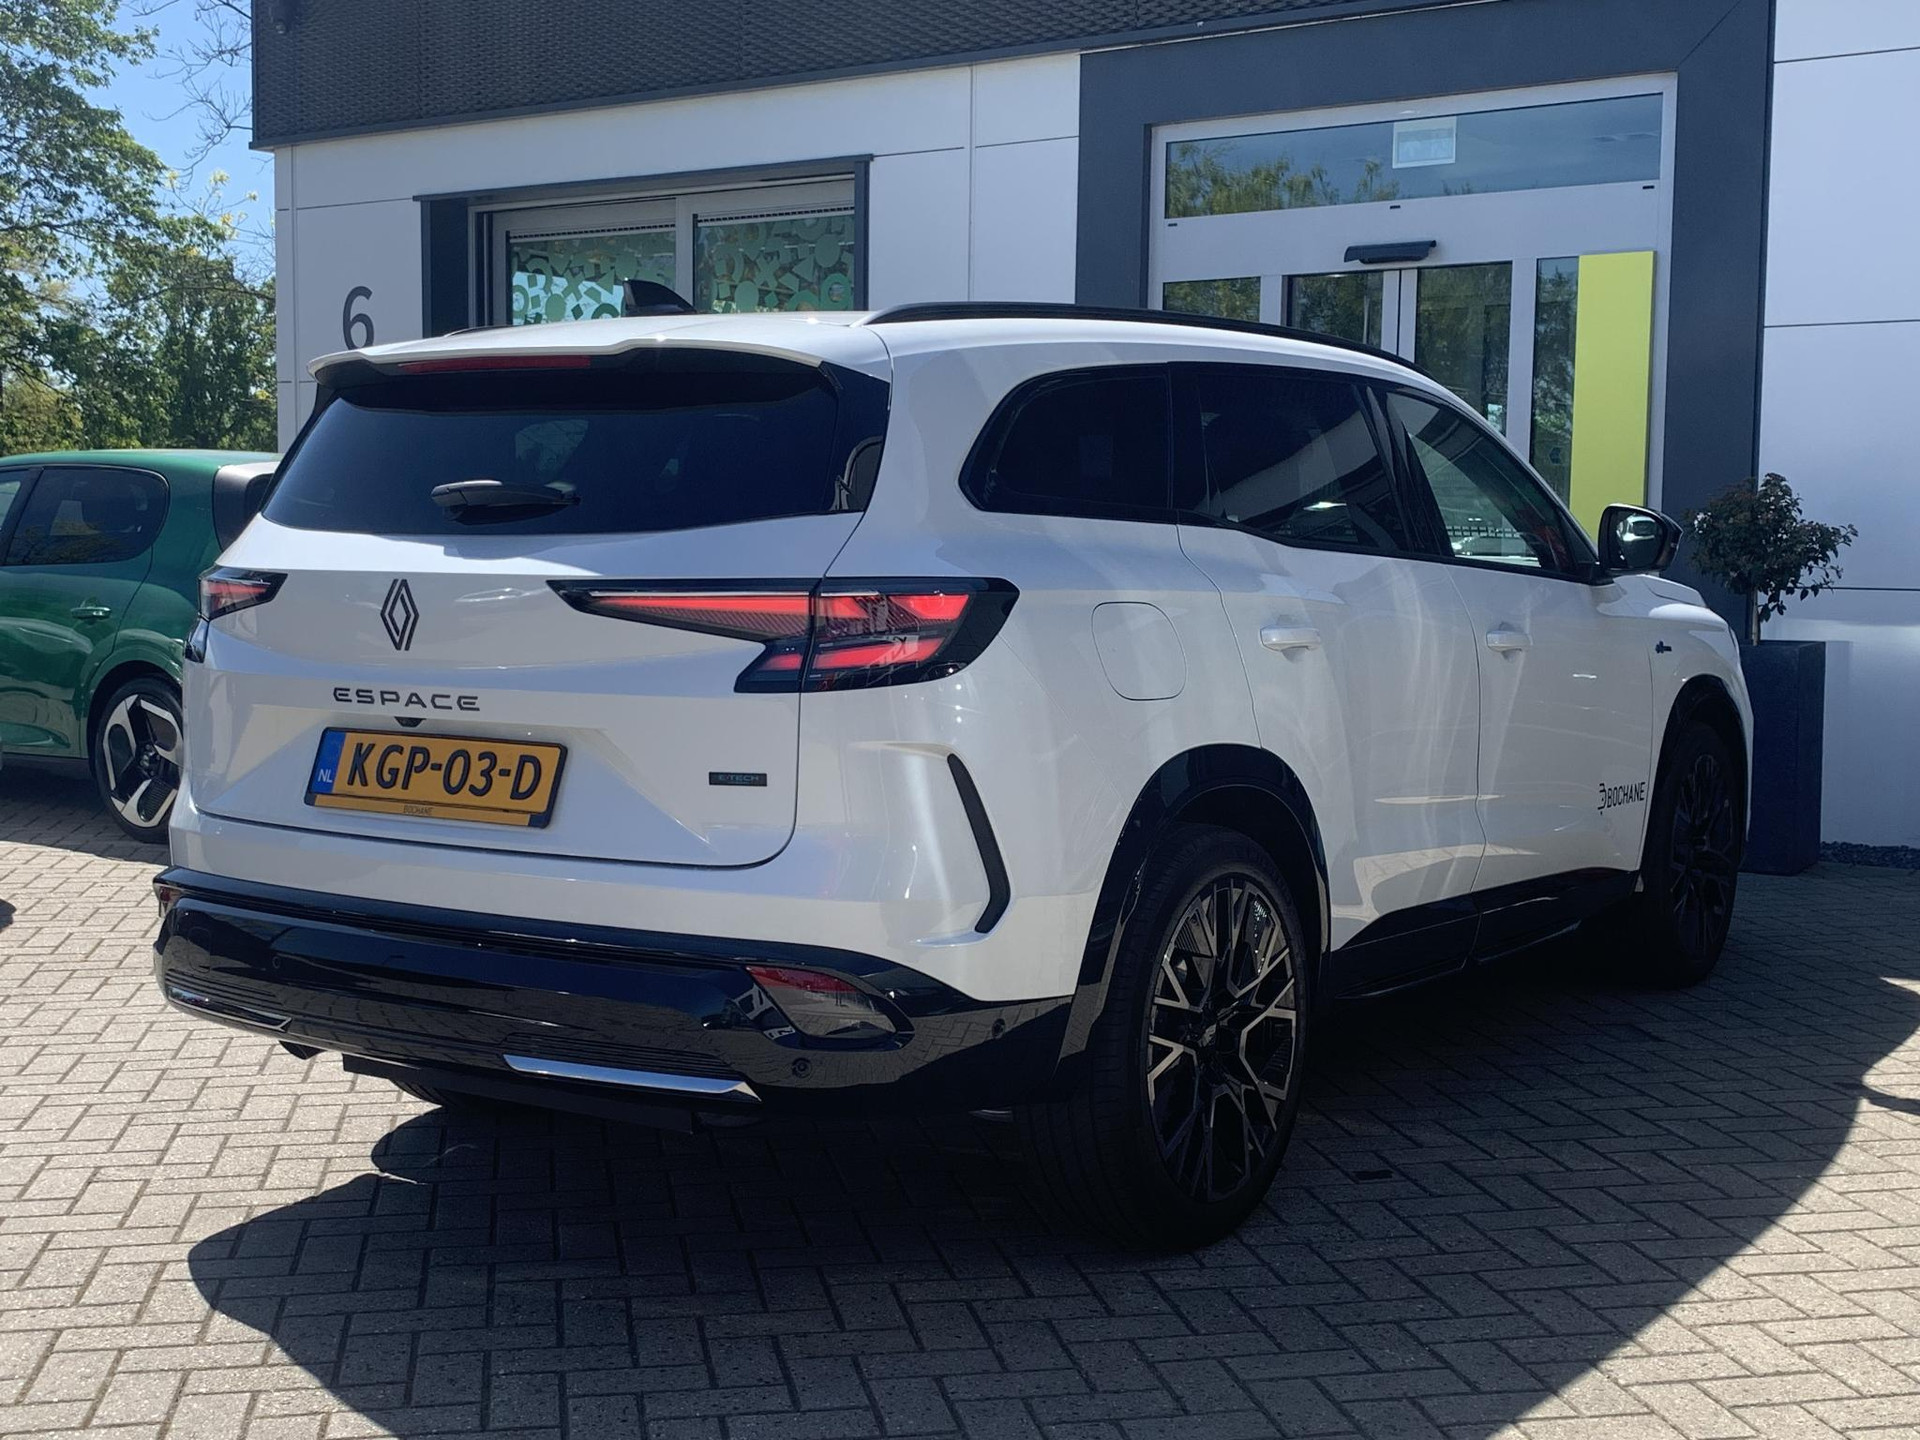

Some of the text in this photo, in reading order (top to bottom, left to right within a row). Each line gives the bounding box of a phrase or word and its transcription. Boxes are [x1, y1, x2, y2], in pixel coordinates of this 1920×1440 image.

[343, 286, 374, 350] 6
[333, 687, 480, 711] ESPACE
[317, 768, 333, 783] NL
[347, 742, 542, 800] KGP-03-D
[1607, 782, 1646, 808] BOCHANE
